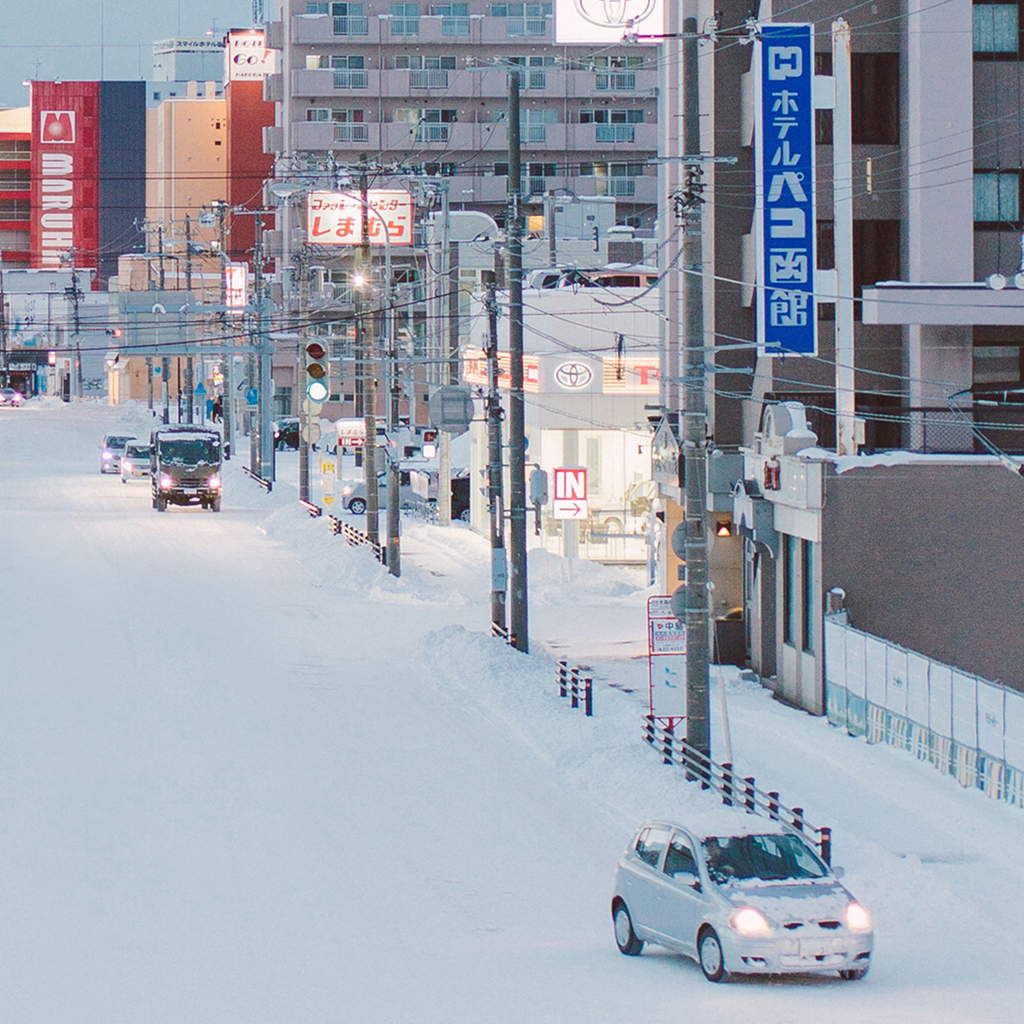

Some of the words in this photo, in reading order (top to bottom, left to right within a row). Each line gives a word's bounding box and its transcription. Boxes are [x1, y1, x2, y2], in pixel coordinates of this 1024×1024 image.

[41, 153, 74, 270] MARUHA
[312, 216, 407, 237] しまむら
[341, 437, 351, 446] IN
[556, 471, 585, 498] IN
